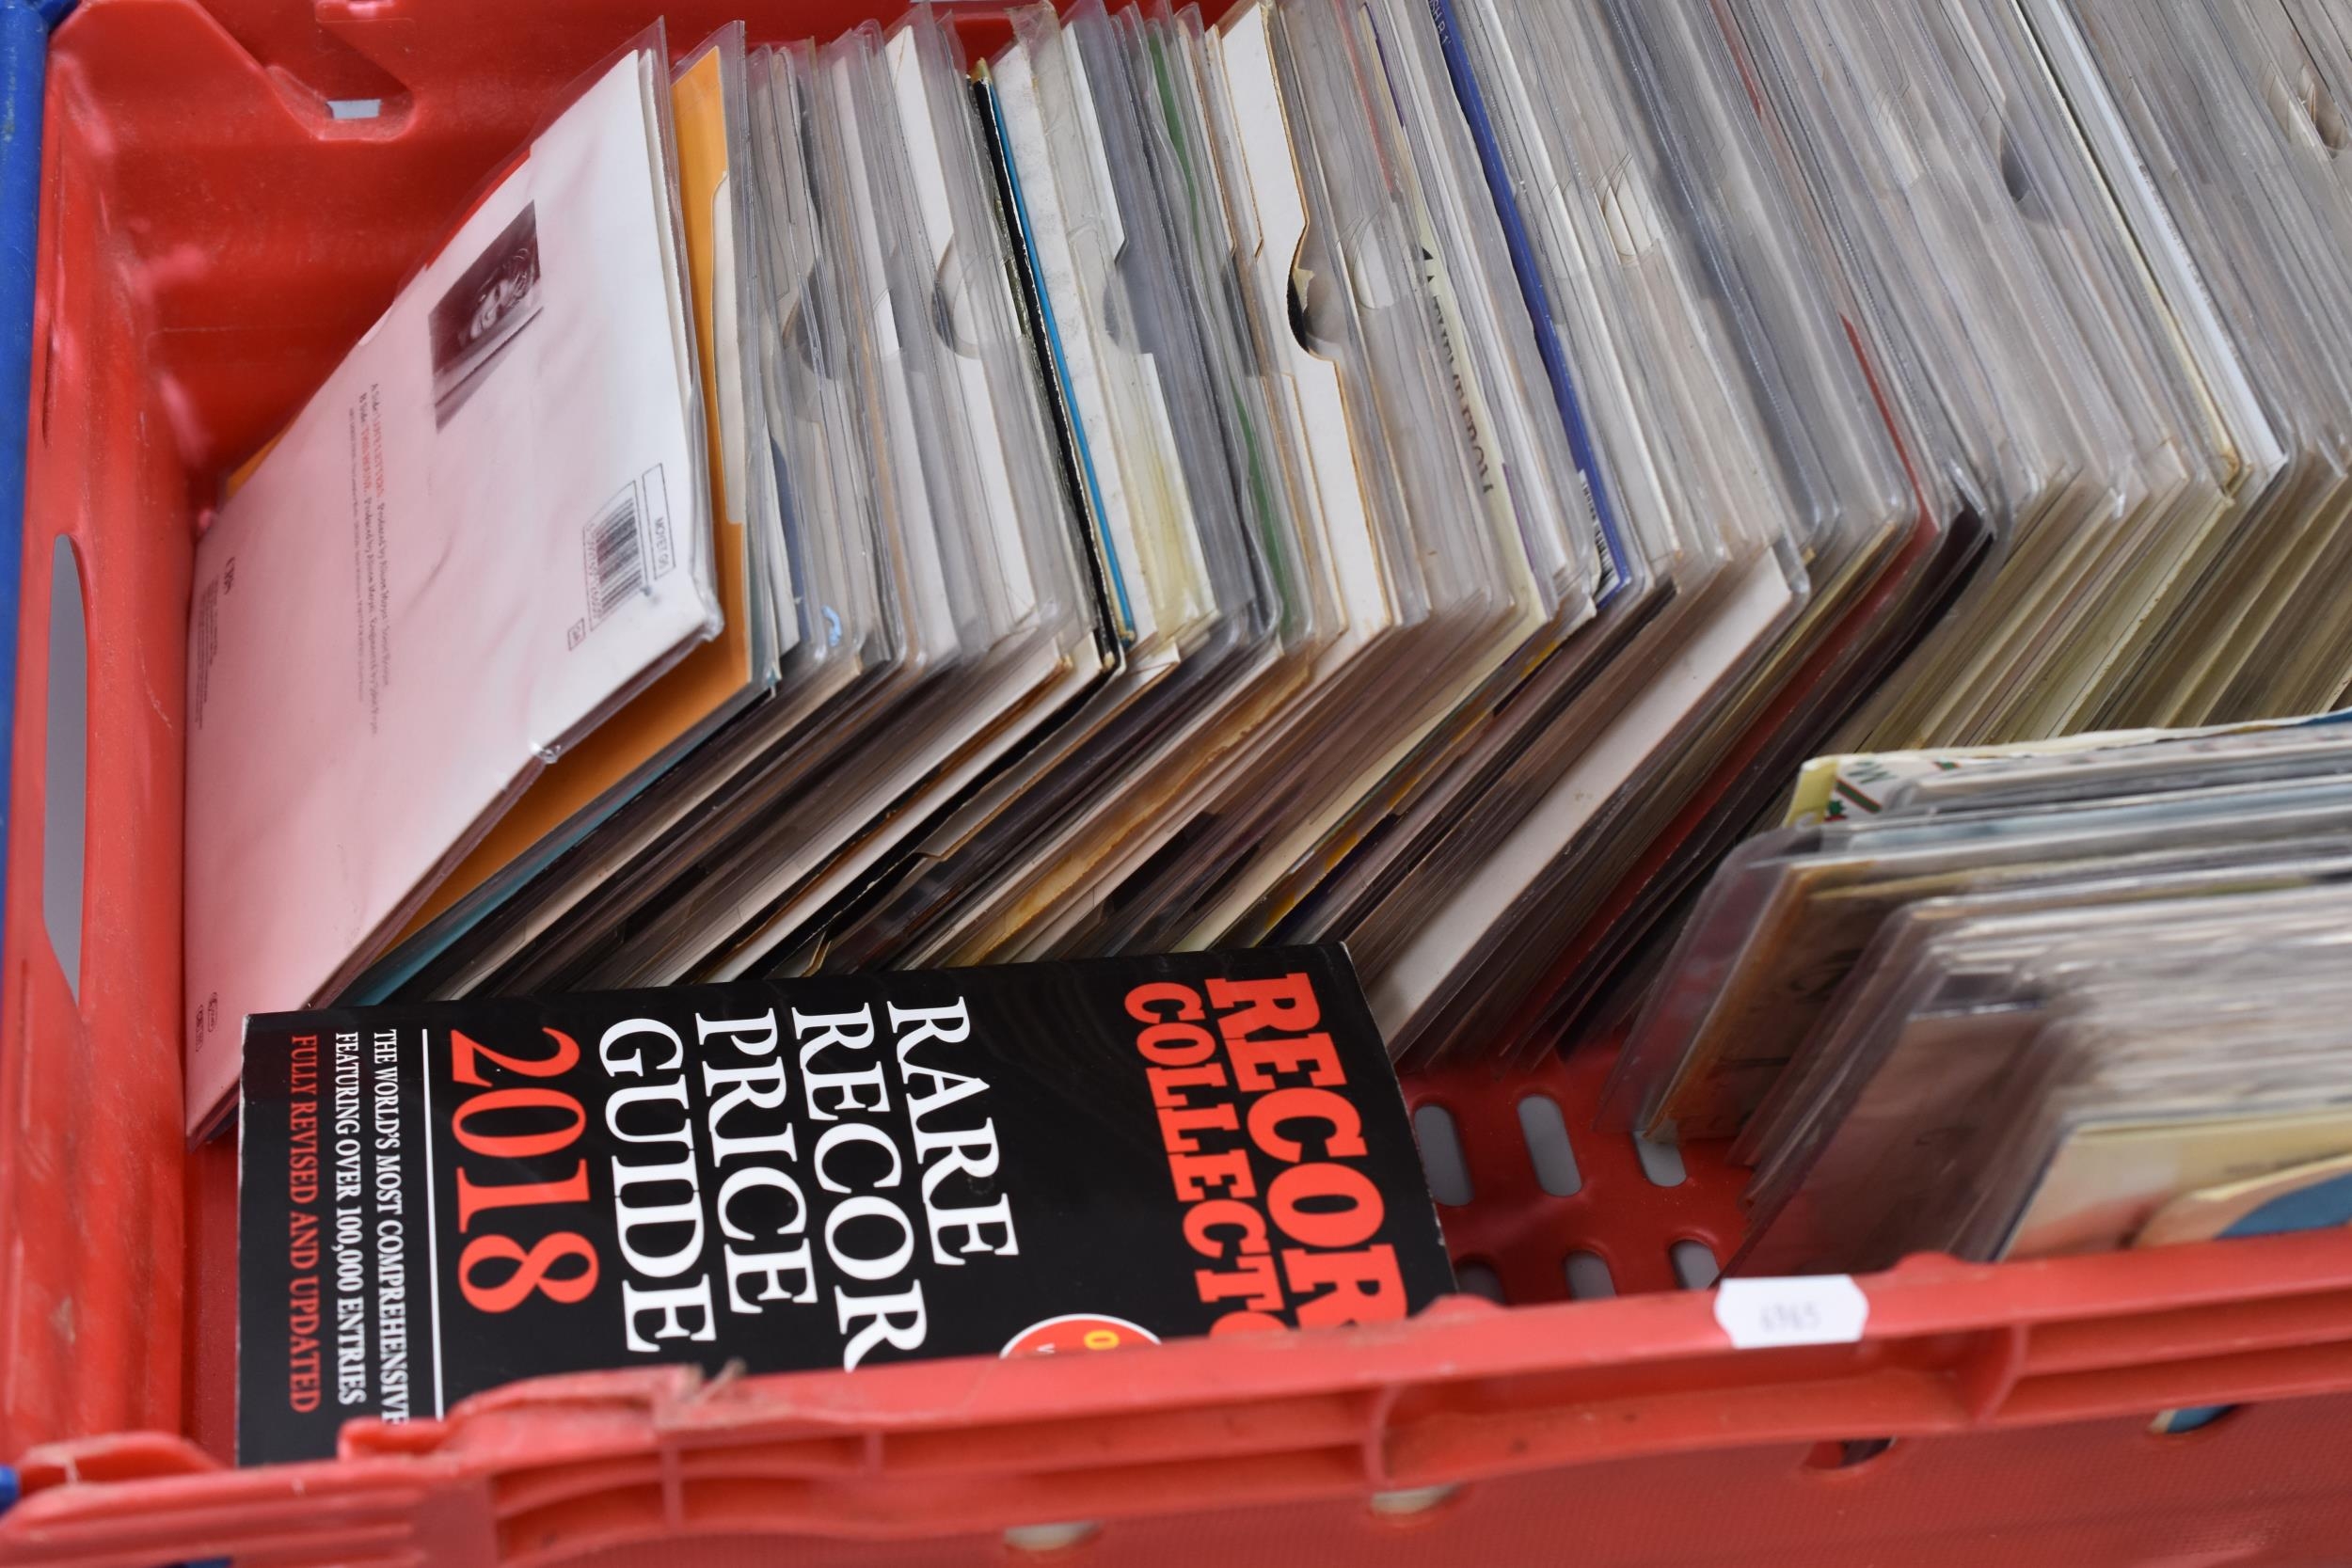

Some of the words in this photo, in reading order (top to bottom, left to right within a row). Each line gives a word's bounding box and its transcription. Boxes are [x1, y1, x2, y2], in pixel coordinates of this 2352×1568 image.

[290, 1035, 318, 1095] FULLY
[335, 1032, 360, 1135] FEATURING
[374, 1029, 397, 1064] THE
[289, 1101, 319, 1204] REVISED
[374, 1066, 401, 1149] WORLD'S
[887, 996, 1019, 1265] RARE
[336, 1139, 362, 1201] OVER
[376, 1154, 403, 1215] MOST
[451, 1027, 599, 1313] 2018
[599, 1018, 716, 1352] GUIDE
[695, 1007, 818, 1313] PRICE
[289, 1212, 320, 1269] AND
[331, 1207, 364, 1291] 100,000
[290, 1275, 322, 1413] UPDATED
[337, 1296, 367, 1405] ENTRIES
[376, 1221, 410, 1424] COMPREHENSIVE
